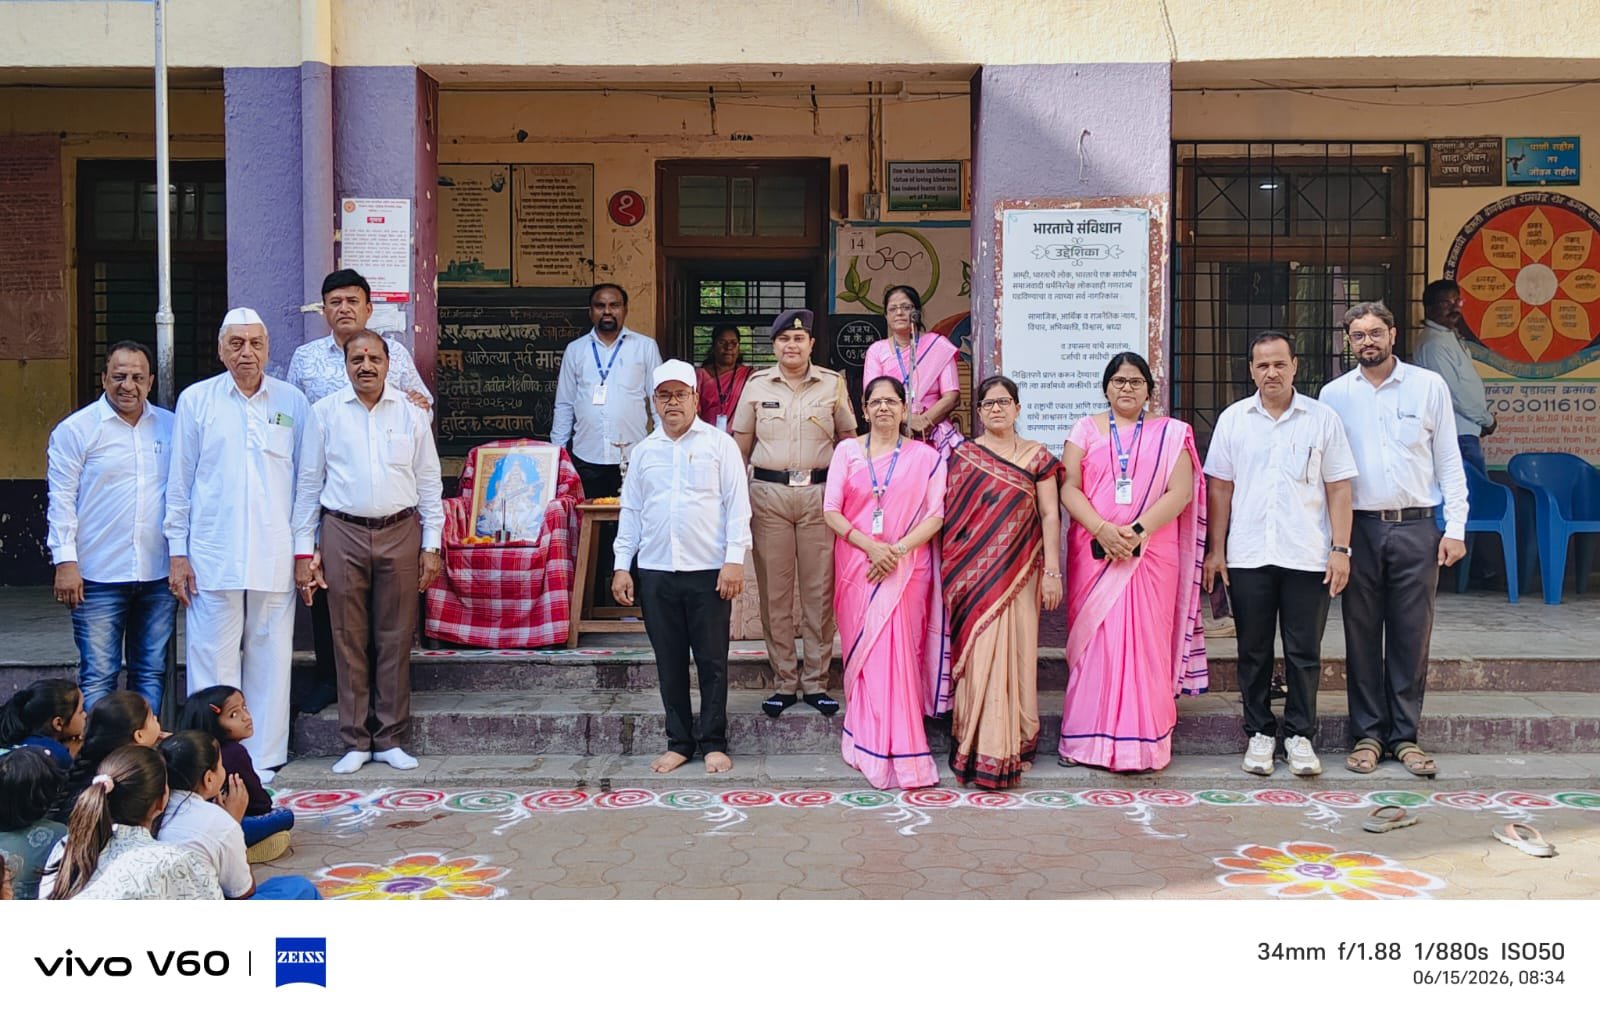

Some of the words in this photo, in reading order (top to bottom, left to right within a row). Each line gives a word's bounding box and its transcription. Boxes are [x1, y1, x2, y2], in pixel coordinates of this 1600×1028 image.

[1441, 153, 1460, 162] सादा
[1033, 219, 1074, 235] भारताचे
[1076, 219, 1122, 235] संविधान
[850, 238, 865, 250] 14
[1055, 245, 1099, 260] उद्देशिका
[1486, 399, 1600, 413] 703011610
[1563, 436, 1582, 444] from
